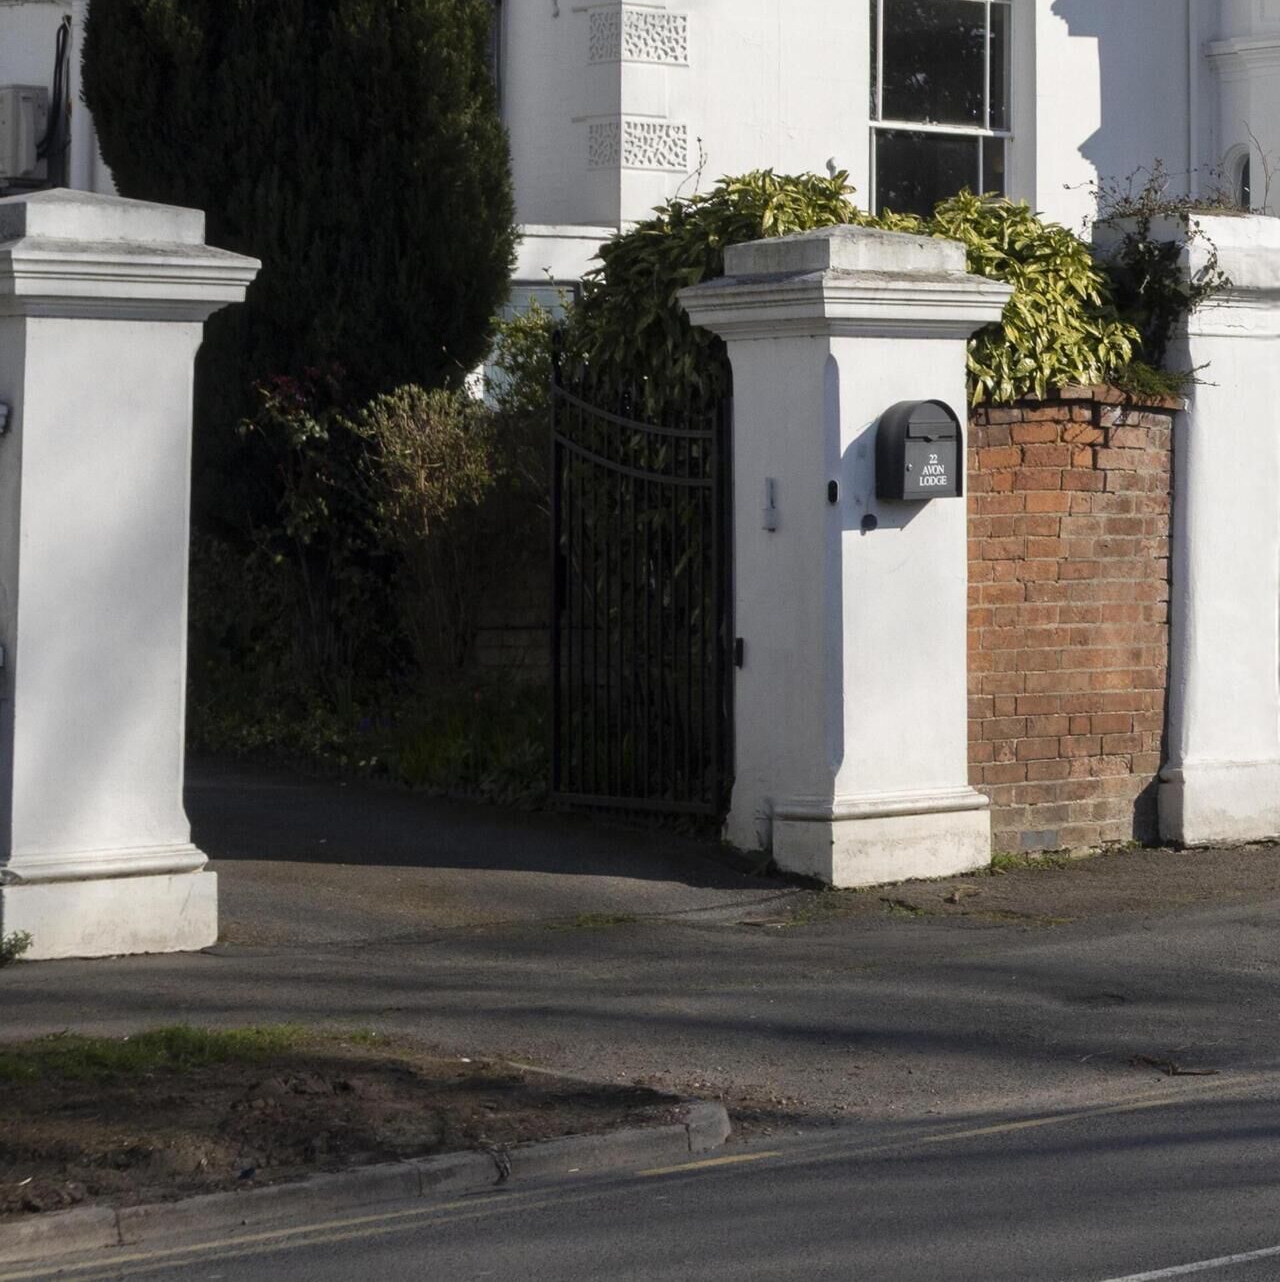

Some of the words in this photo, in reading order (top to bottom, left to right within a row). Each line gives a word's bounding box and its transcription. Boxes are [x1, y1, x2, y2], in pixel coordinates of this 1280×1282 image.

[929, 453, 938, 464] 22
[922, 464, 945, 475] AVON
[919, 475, 947, 486] LODGE
